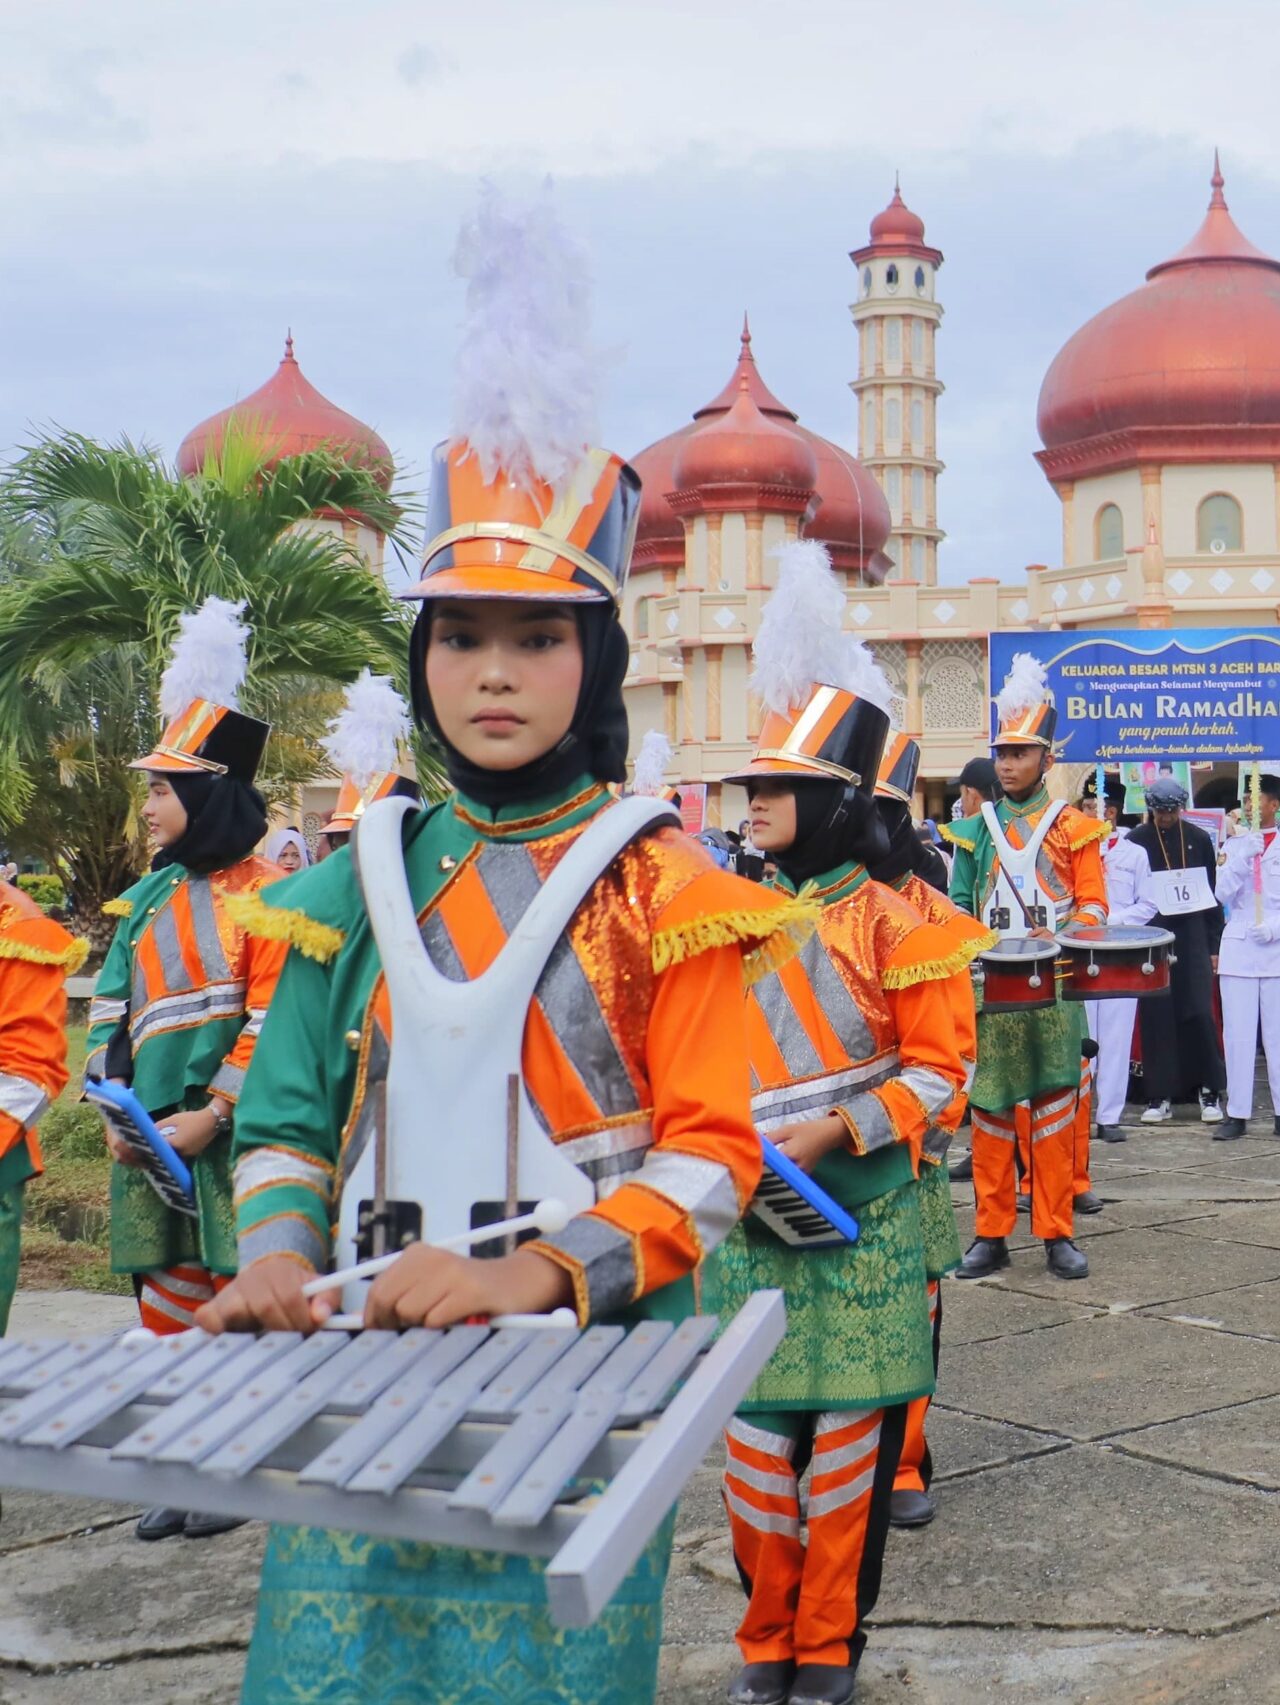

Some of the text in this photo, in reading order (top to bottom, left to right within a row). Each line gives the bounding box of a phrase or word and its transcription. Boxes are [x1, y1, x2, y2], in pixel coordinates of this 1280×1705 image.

[1061, 665, 1126, 677] KELUARGA
[1129, 664, 1168, 676] BESAR
[1172, 663, 1206, 675] MTSN
[1209, 663, 1217, 674] 3
[1220, 663, 1253, 674] ACEH
[1089, 679, 1262, 693] Mengucapkan Selamat Menyambut
[1118, 724, 1151, 740] yang
[1151, 723, 1189, 740] penuh
[1096, 744, 1123, 758] Mari
[1196, 743, 1223, 753] dalam
[1224, 742, 1264, 755] kebaikan
[1173, 884, 1190, 902] 16
